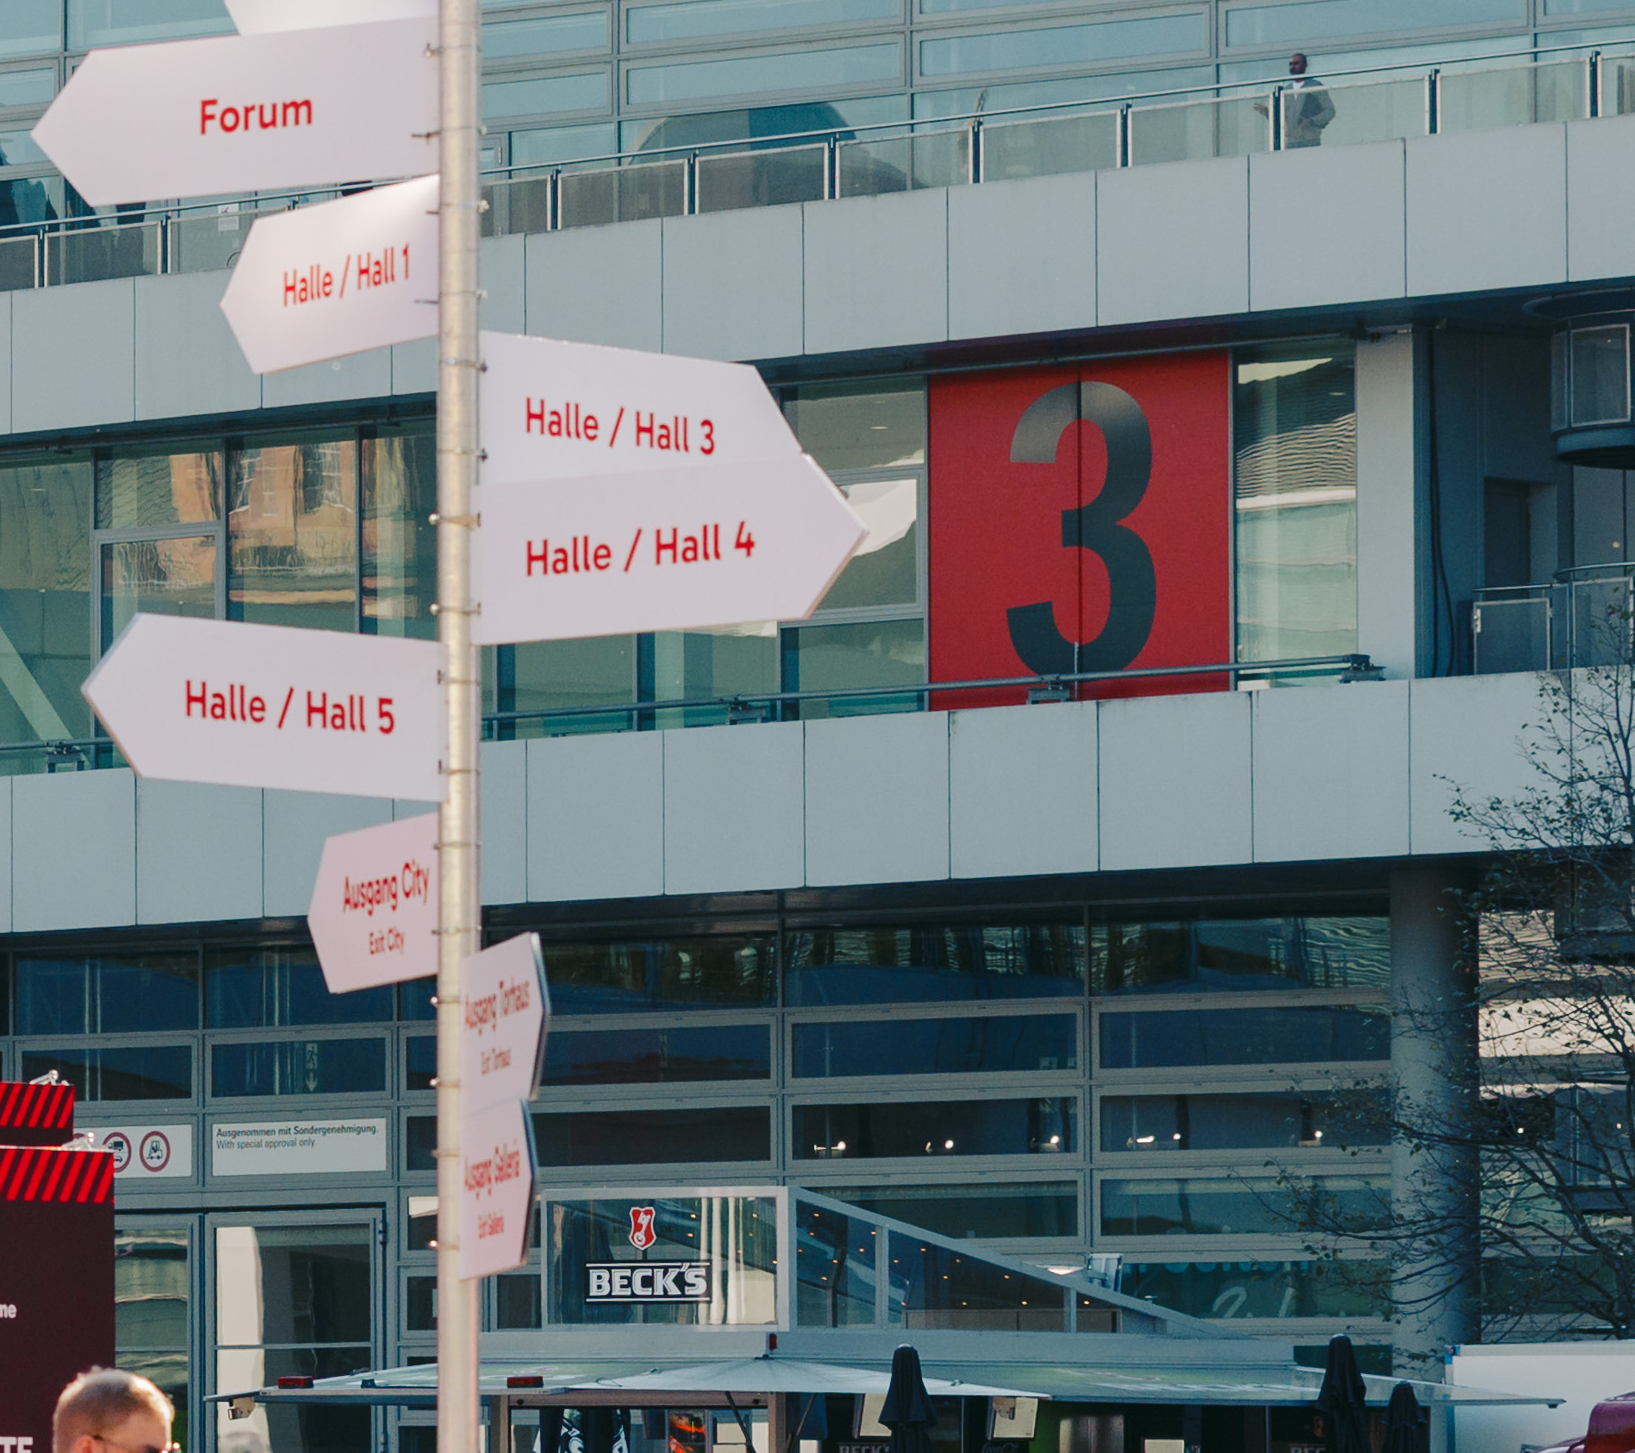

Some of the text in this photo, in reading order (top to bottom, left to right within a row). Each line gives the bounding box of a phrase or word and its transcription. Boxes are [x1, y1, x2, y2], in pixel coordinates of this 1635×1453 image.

[199, 93, 313, 135] Forum
[283, 242, 410, 307] Halle / Hall 1
[525, 399, 716, 454] Halle / Hall 3
[525, 525, 756, 578] Halle / Hall 4
[1006, 379, 1158, 675] 3
[184, 680, 395, 736] Halle / Hall 5
[343, 859, 430, 917] Ausgang City
[370, 927, 405, 955] Exit City
[464, 977, 530, 1037] Ausgang Torhaus
[216, 1124, 379, 1139] Ausgenommen mit Sondergenehmigung.
[216, 1139, 235, 1149] With
[237, 1138, 263, 1150] special
[265, 1137, 297, 1150] approval
[464, 1157, 492, 1200] Ausgang
[589, 1263, 707, 1296] BECK'S
